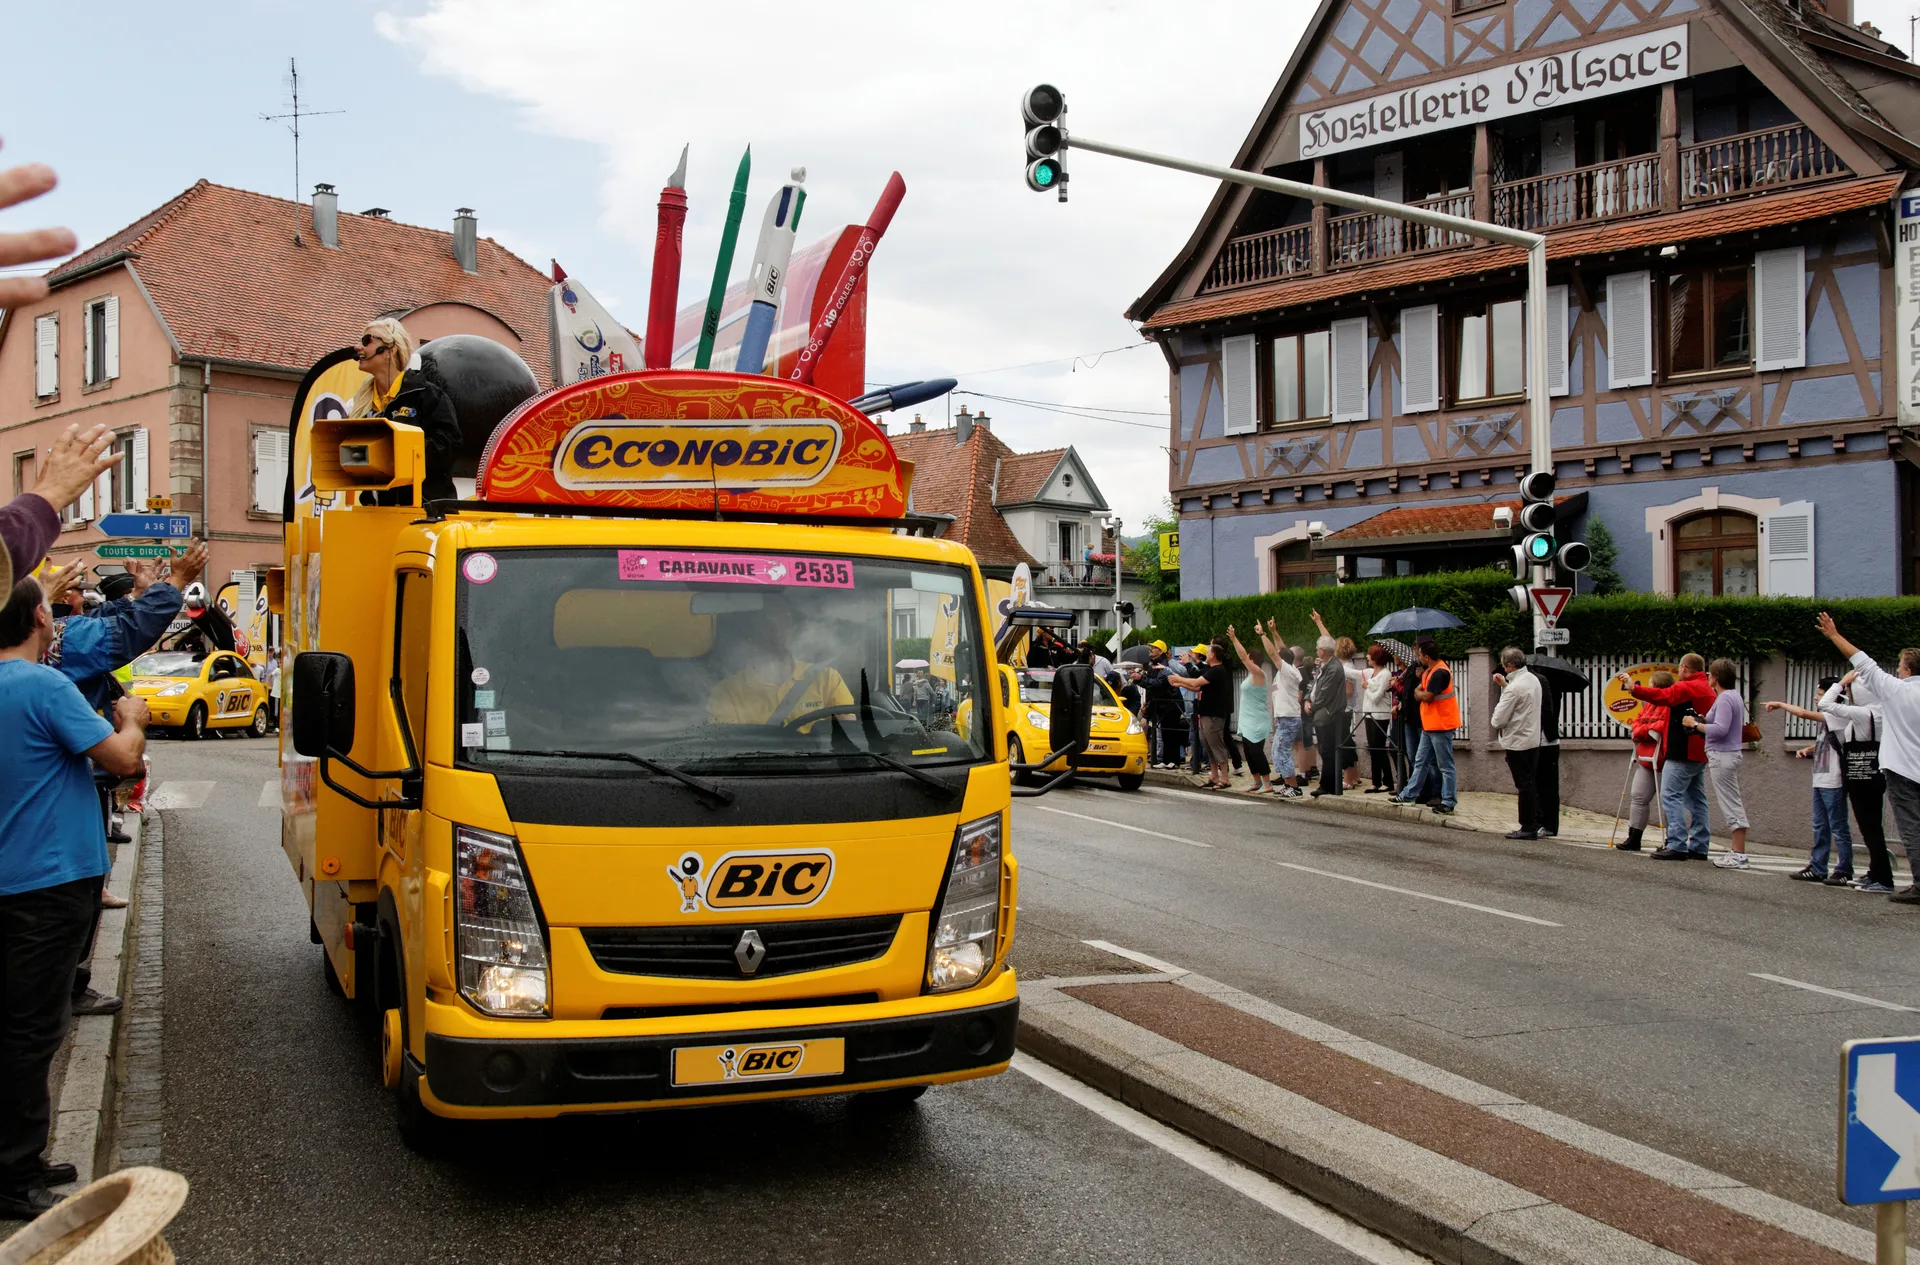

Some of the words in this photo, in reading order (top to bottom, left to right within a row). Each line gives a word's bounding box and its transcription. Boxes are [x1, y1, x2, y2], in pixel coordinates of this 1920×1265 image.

[1302, 81, 1490, 157] Hostellerie
[1507, 40, 1682, 107] d'Alsace
[1899, 222, 1920, 242] HO
[836, 275, 857, 310] COULEUR
[145, 522, 150, 530] A
[153, 522, 165, 530] 36
[104, 548, 135, 556] TOUTES
[140, 548, 187, 556] DIRECTINS
[659, 559, 756, 577] CARAVANE
[794, 561, 849, 584] 2535
[225, 694, 251, 713] BiC
[715, 861, 827, 899] BiC
[742, 1050, 799, 1071] BiC
